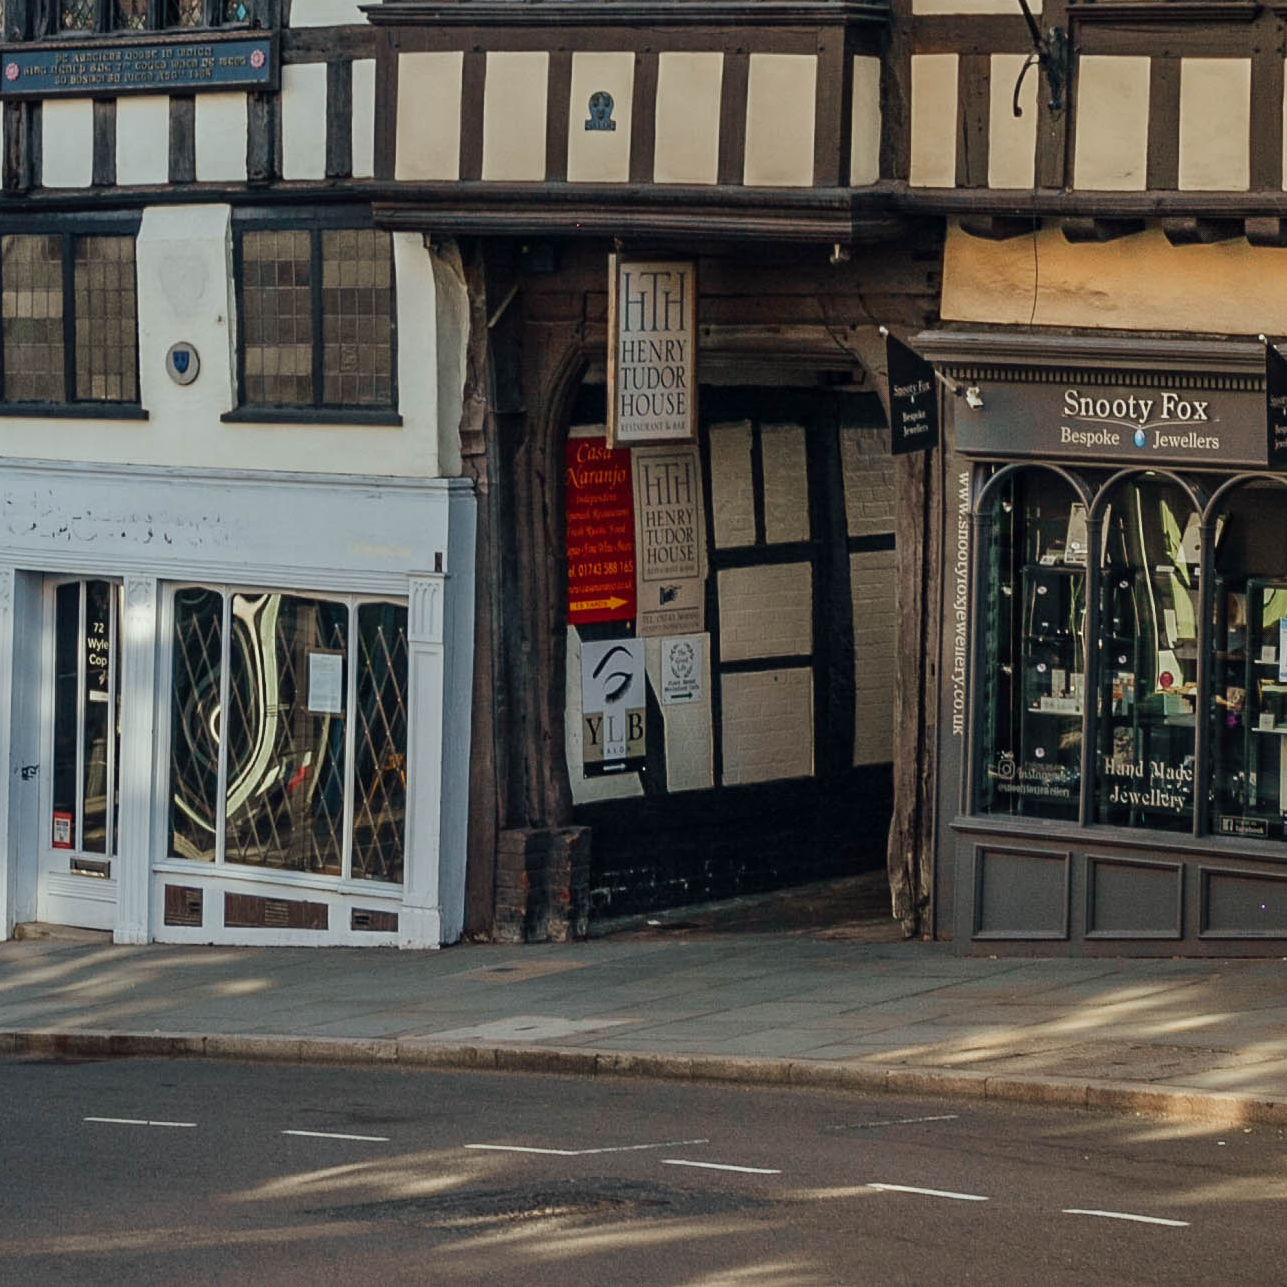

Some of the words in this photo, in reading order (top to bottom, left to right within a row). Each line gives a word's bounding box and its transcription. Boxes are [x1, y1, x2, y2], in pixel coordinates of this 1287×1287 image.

[621, 339, 687, 364] HENRY
[621, 365, 686, 390] TUDOR
[620, 392, 686, 417] HOUSE
[1063, 389, 1153, 423] Snooty
[1161, 392, 1209, 420] Fox
[1060, 426, 1120, 448] Bespoke
[1152, 430, 1220, 450] Jewellers
[576, 442, 613, 463] Casa
[567, 464, 626, 490] Naranjo
[646, 509, 693, 528] HENRY
[646, 527, 694, 547] TUDOR
[647, 544, 695, 564] HOUSE
[952, 471, 970, 736] www.snootyfoxjewellery.co.uk
[93, 622, 105, 634] 72
[87, 637, 109, 652] Wyle
[88, 653, 108, 668] Cop
[1104, 756, 1144, 779] Hand
[1150, 761, 1194, 789] Made
[1109, 785, 1186, 812] Jewellery
